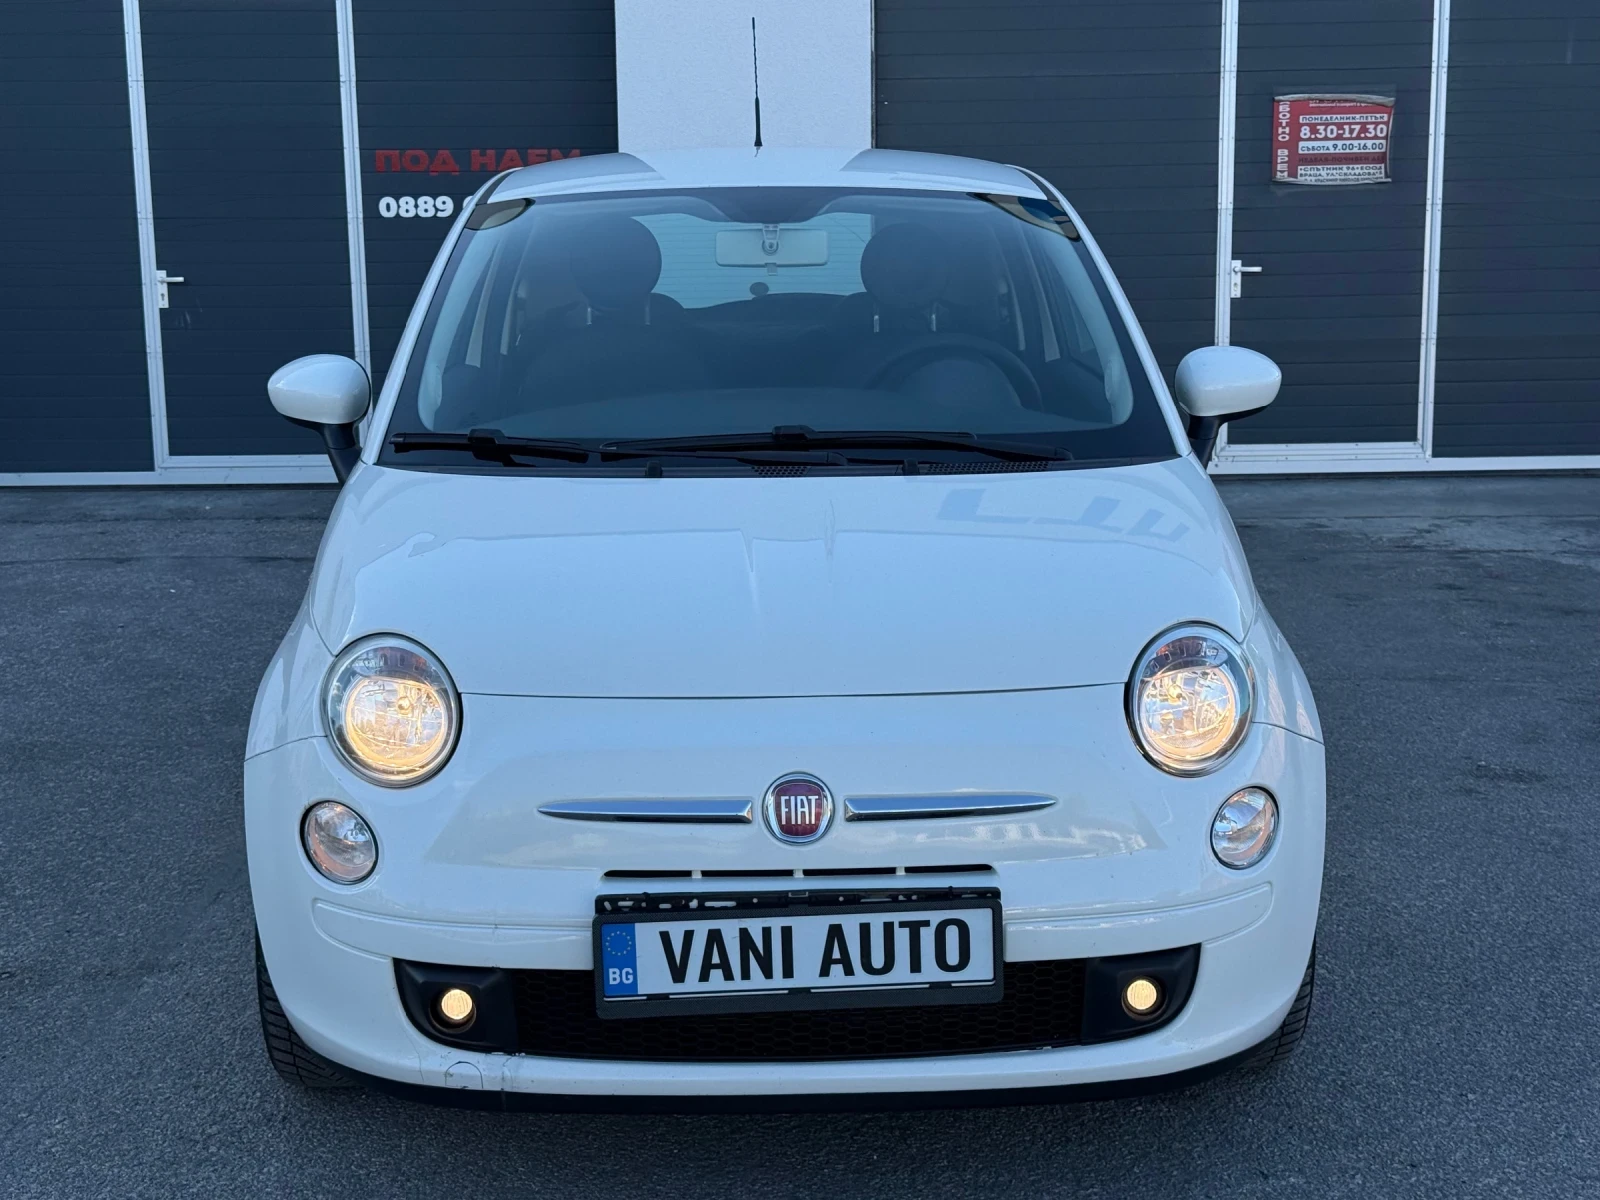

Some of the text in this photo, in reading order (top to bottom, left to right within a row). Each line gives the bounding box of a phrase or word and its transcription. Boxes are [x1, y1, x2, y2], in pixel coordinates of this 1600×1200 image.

[1300, 124, 1387, 139] 8.30-17.30
[1332, 142, 1384, 151] 9.00-16.00
[375, 149, 459, 175] ПОД
[378, 195, 454, 218] 0889
[780, 795, 819, 825] FIAT
[658, 917, 972, 984] VANI AUTO
[608, 967, 634, 985] BG
